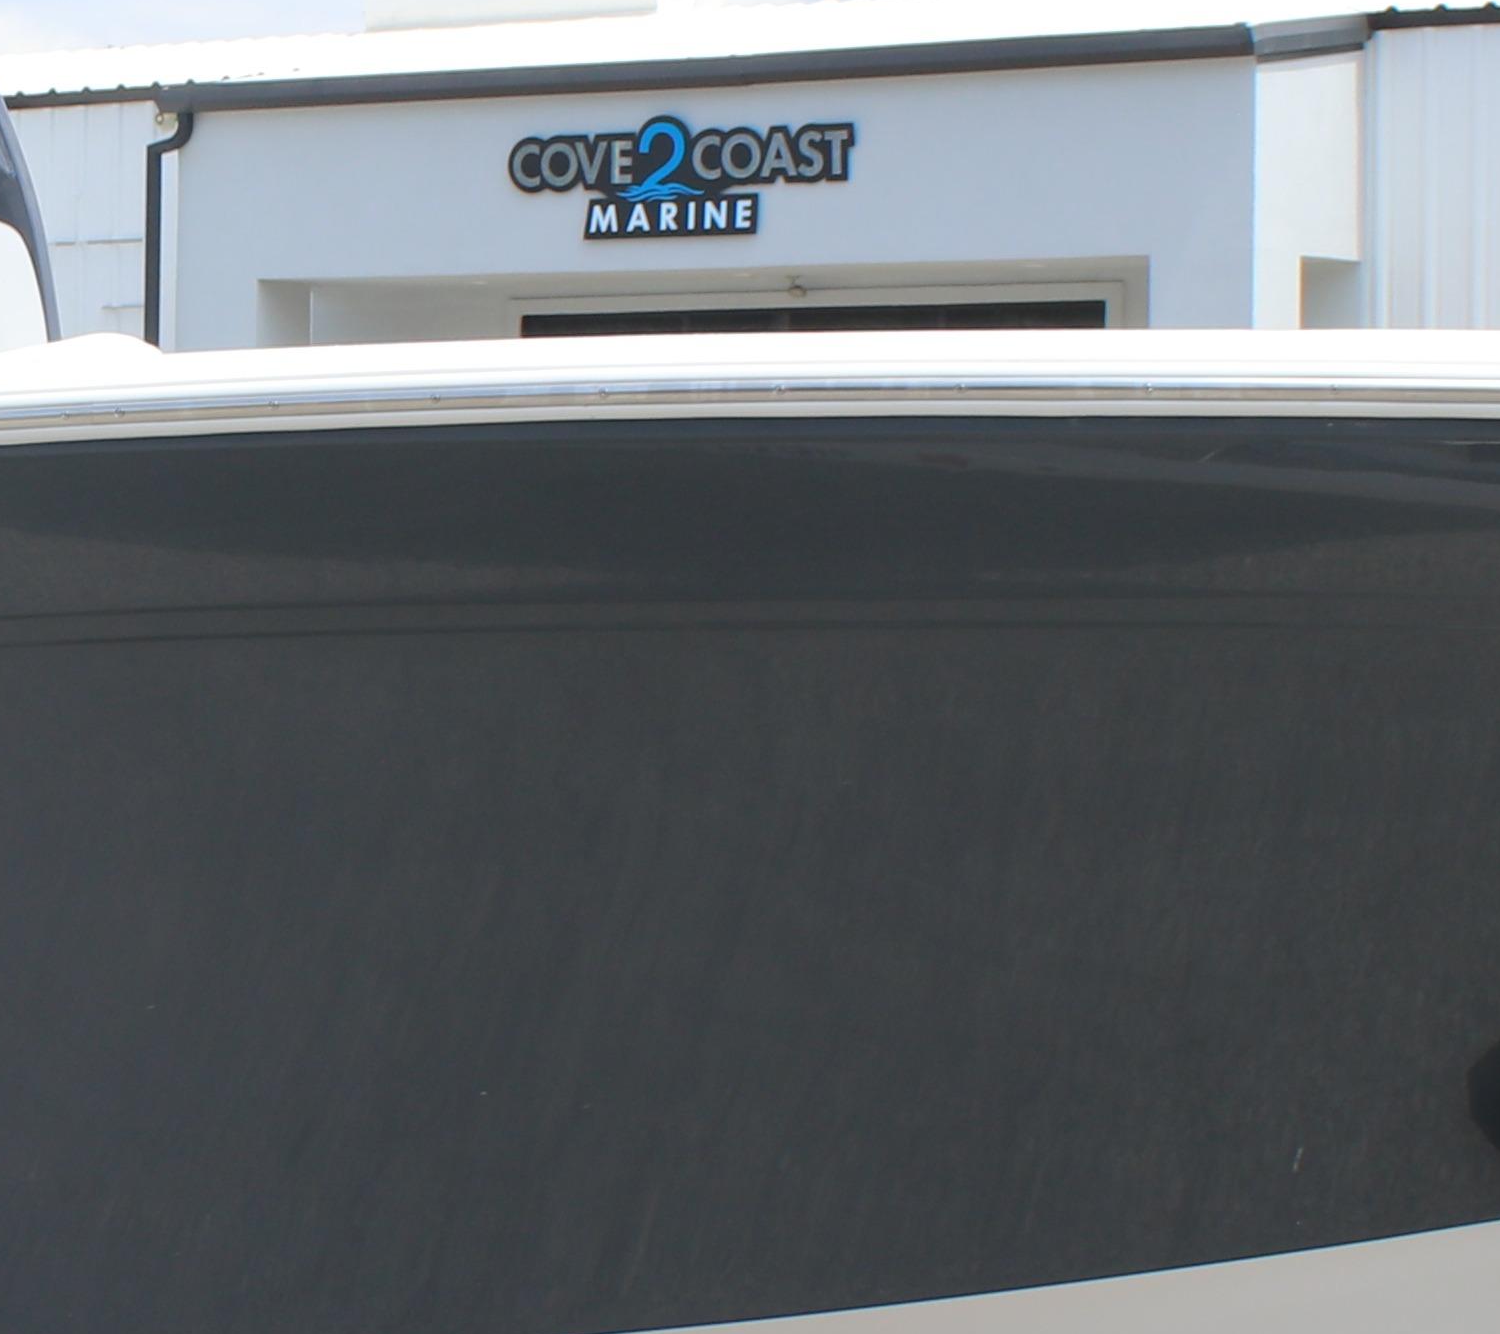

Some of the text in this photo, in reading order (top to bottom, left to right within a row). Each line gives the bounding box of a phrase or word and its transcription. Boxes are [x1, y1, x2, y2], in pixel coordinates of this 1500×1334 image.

[510, 120, 851, 189] COVE 2 COAST
[588, 198, 754, 234] MARINE
